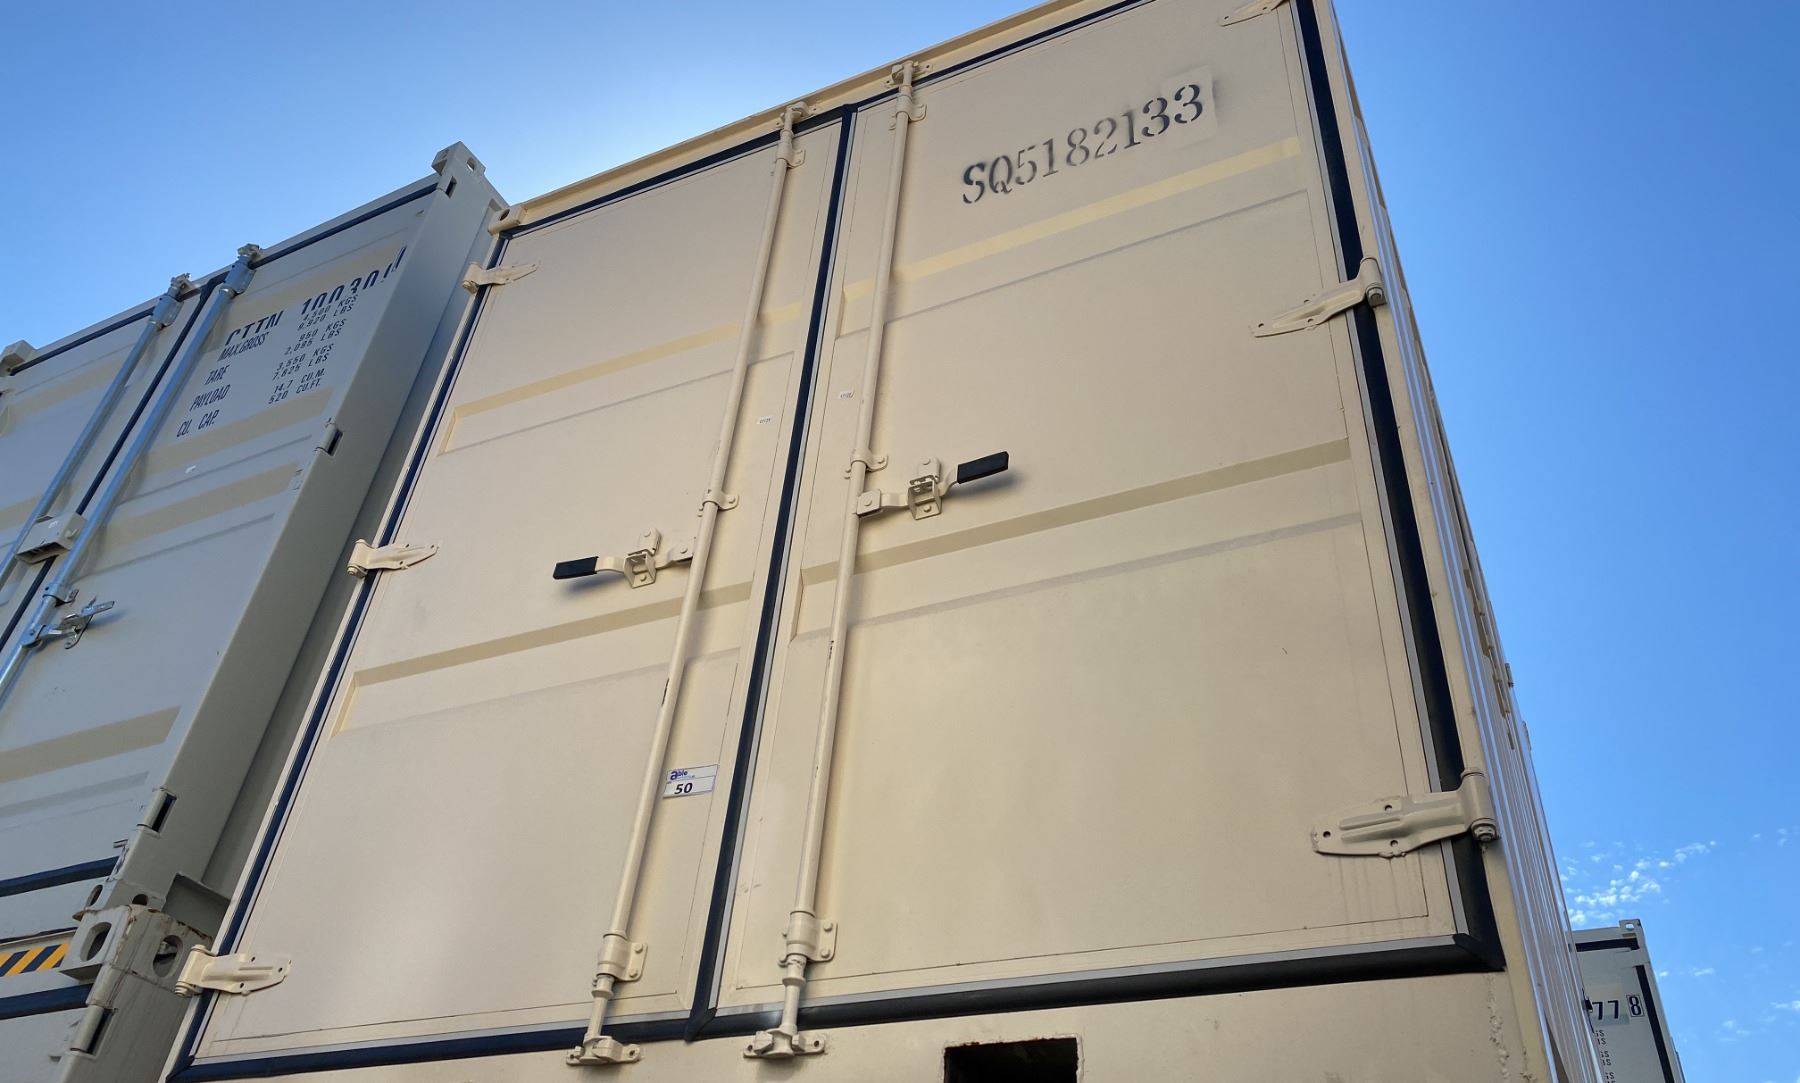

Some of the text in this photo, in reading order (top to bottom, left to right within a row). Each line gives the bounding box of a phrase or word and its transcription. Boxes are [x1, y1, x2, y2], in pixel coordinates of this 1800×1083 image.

[962, 84, 1203, 204] SQ5182133
[338, 294, 359, 308] KGS
[333, 304, 354, 317] LBS
[326, 318, 347, 332] KGS
[320, 328, 341, 341] LBS
[308, 353, 329, 367] LBS
[189, 384, 231, 411] PAYLOAD
[313, 343, 334, 357] KGS
[268, 390, 288, 404] 520
[674, 782, 693, 795] 50
[1629, 996, 1642, 1015] 8
